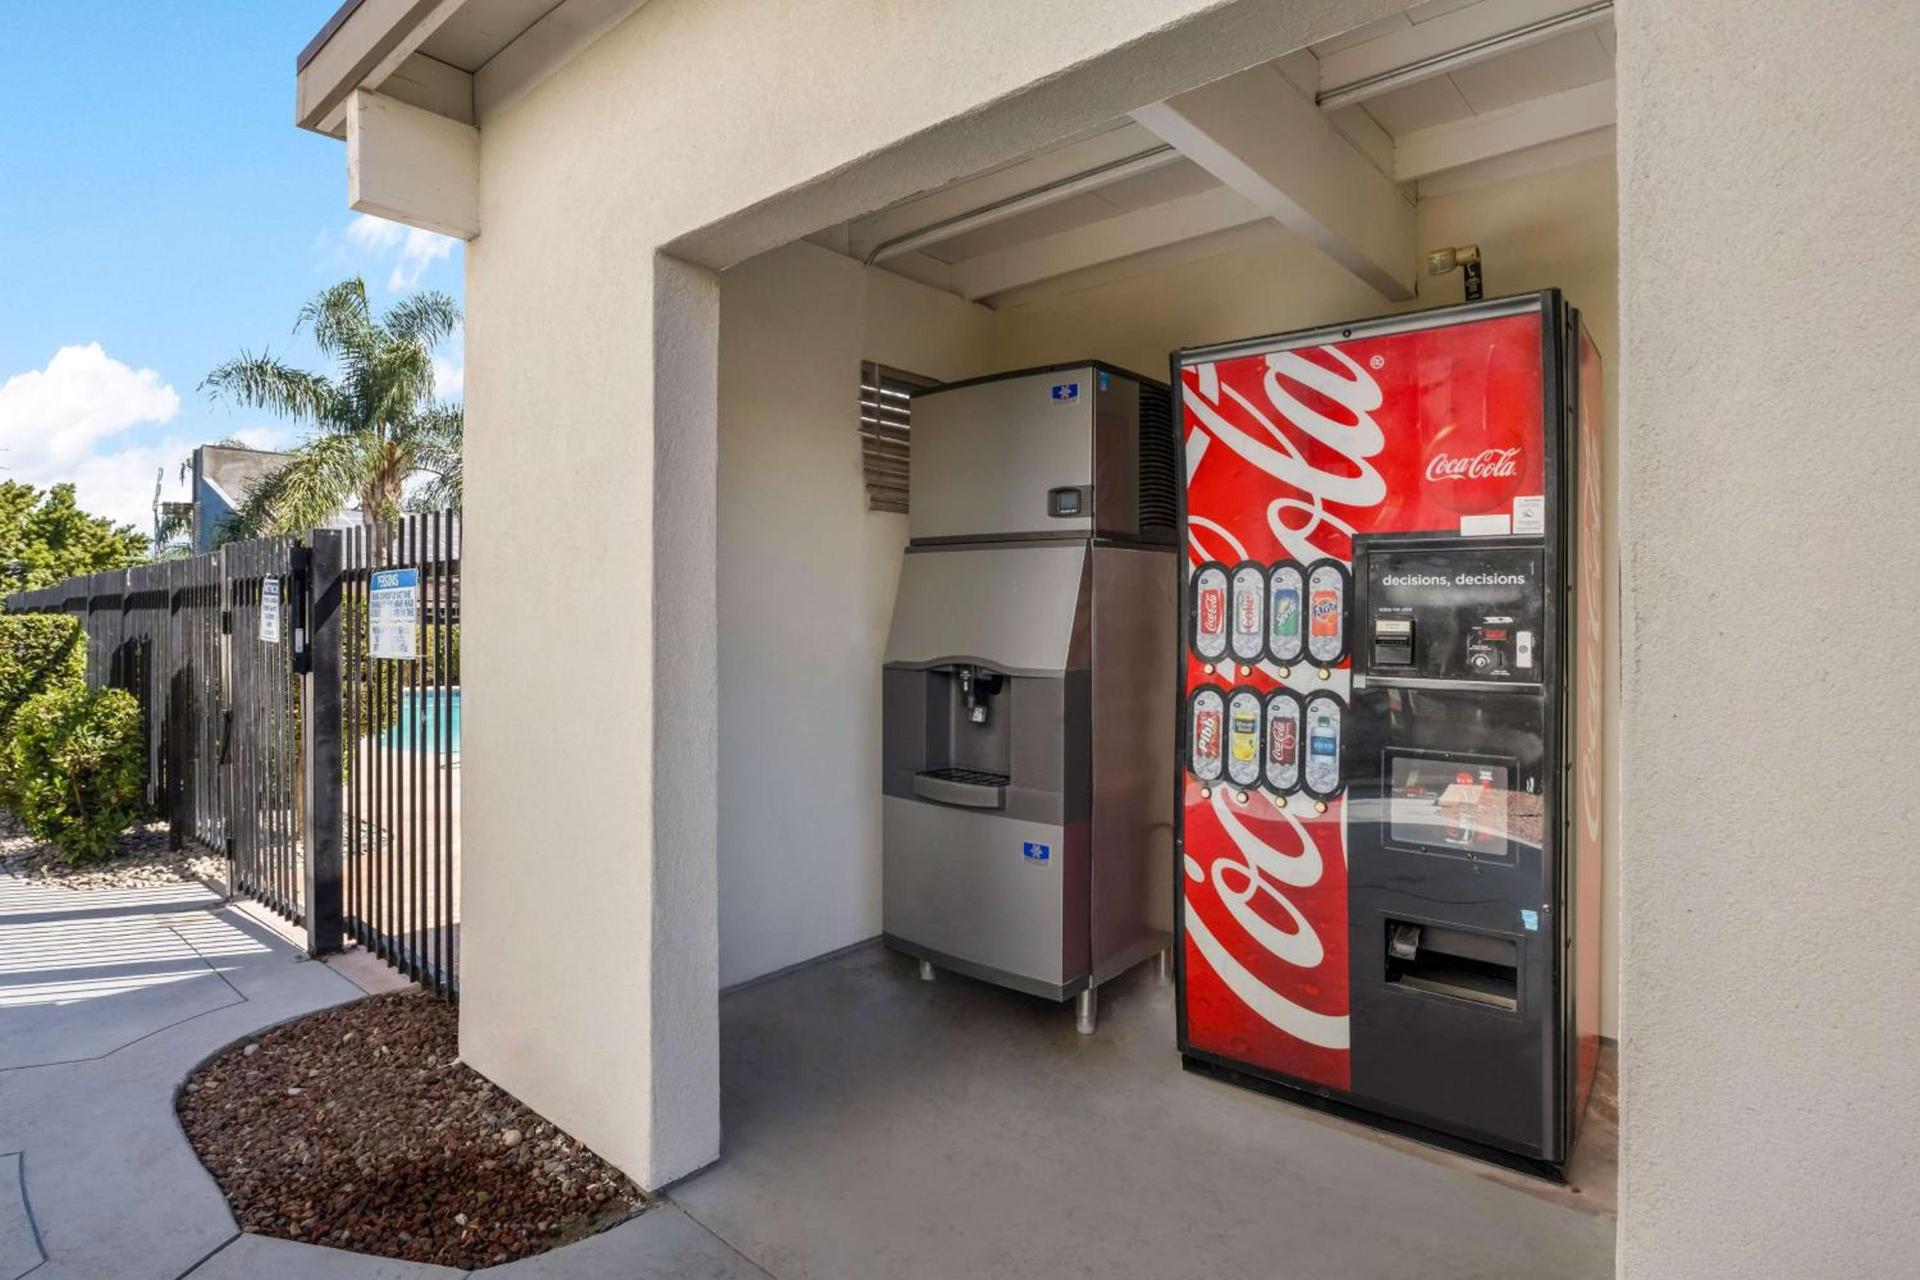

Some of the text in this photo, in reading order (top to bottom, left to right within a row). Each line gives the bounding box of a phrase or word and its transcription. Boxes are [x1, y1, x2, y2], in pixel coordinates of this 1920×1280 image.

[1426, 447, 1521, 482] Coca-Cola
[1382, 573, 1525, 587] decisions, decisions
